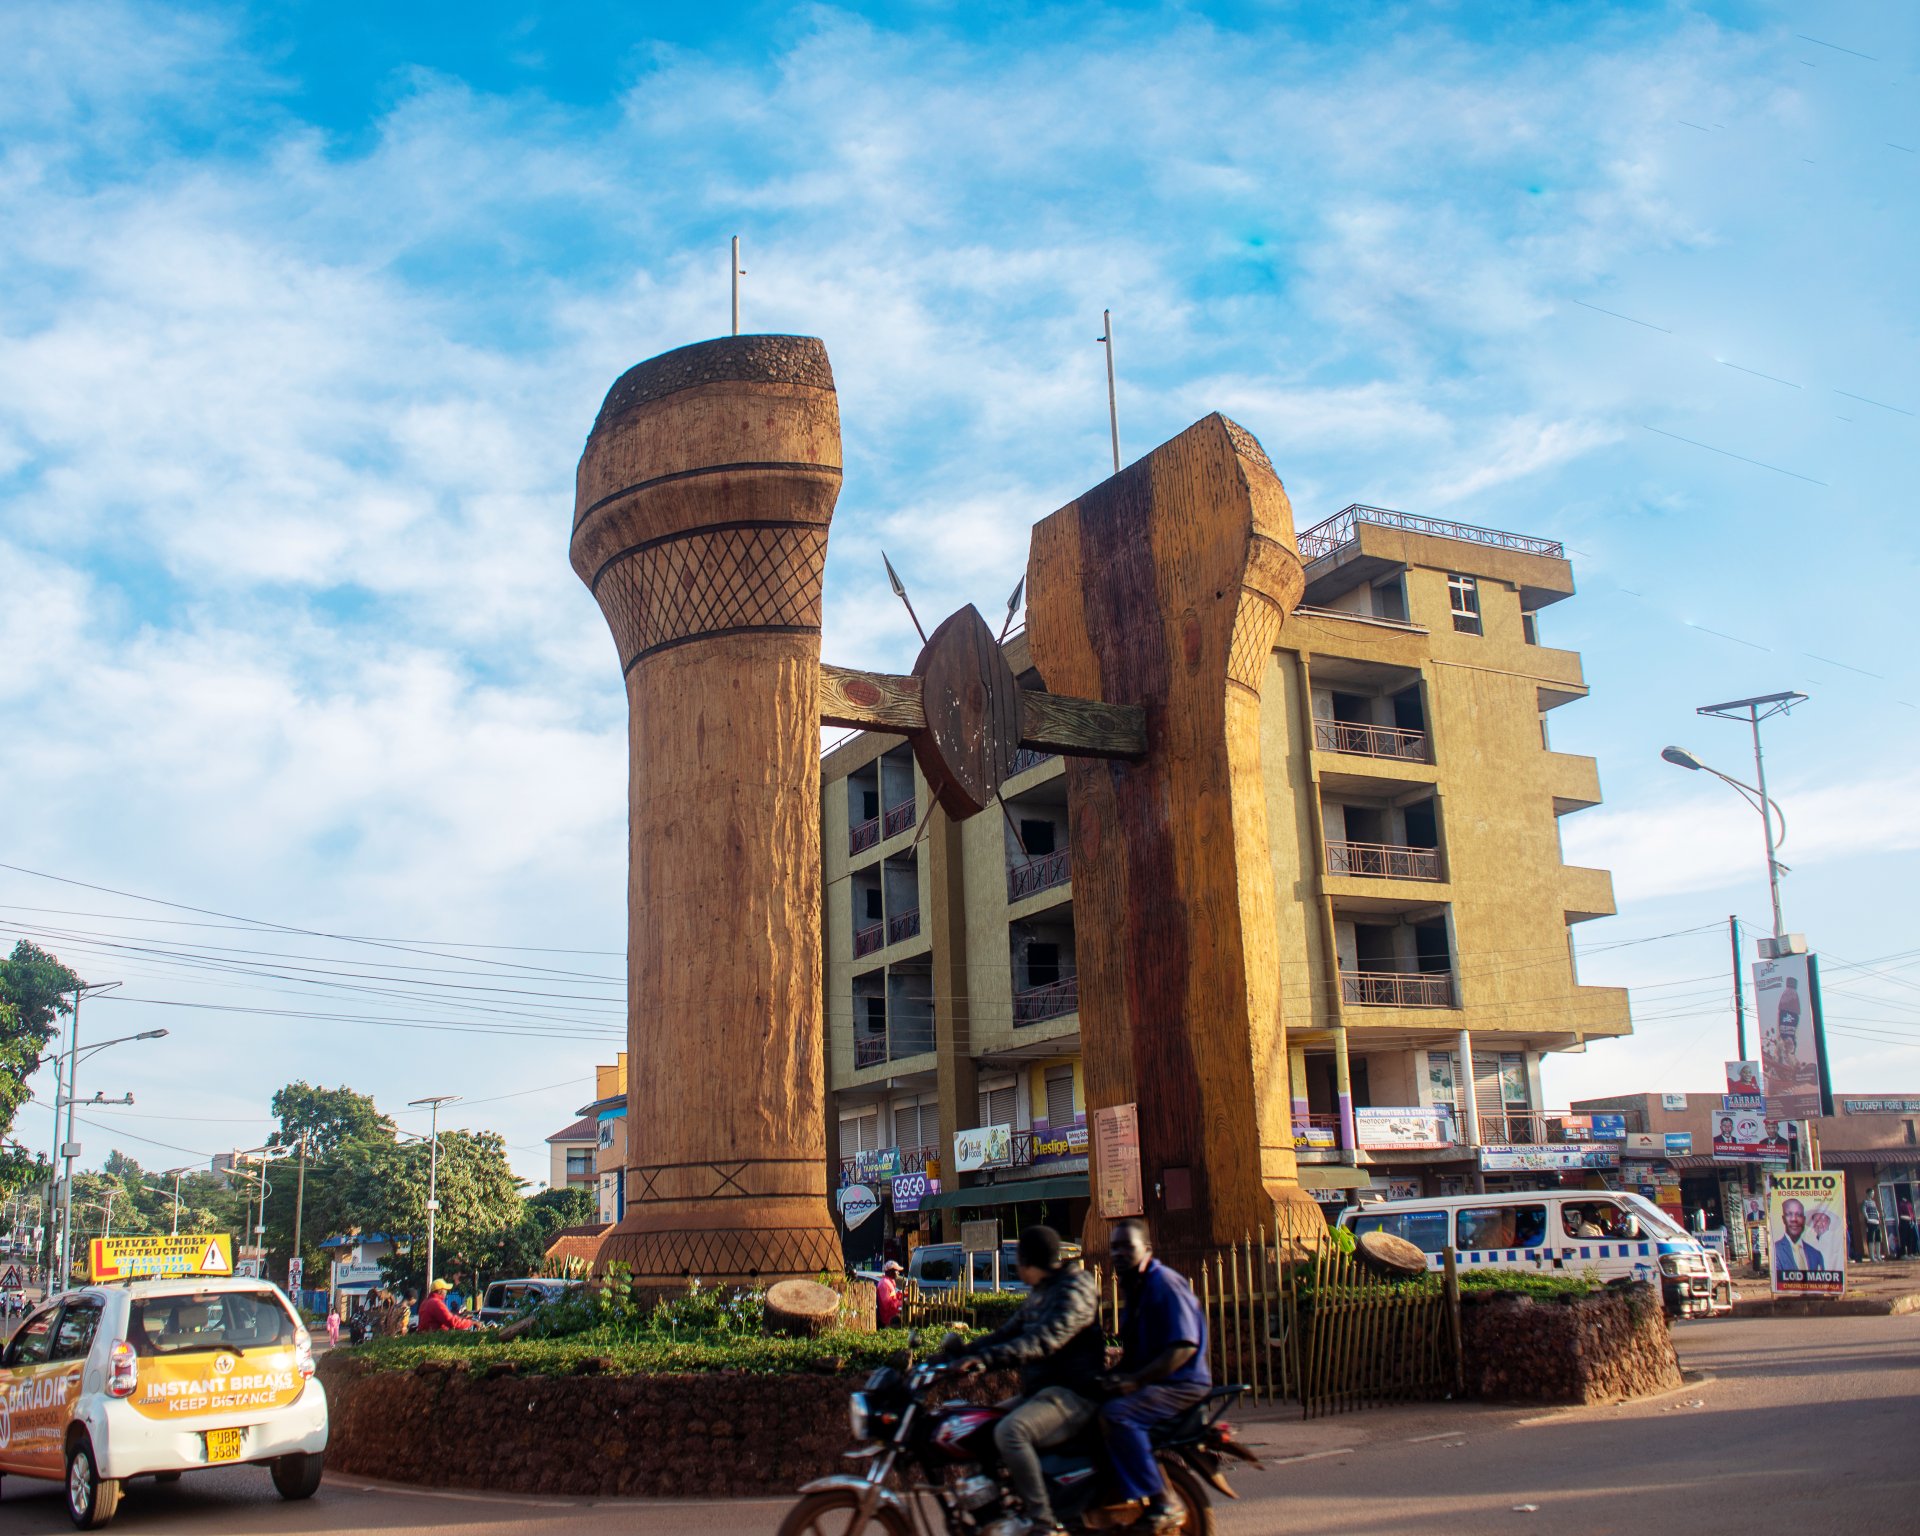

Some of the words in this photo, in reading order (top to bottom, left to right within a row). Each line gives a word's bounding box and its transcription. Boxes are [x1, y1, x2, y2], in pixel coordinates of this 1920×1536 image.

[1294, 1136, 1307, 1147] ge
[968, 1150, 982, 1158] FOODS
[894, 1175, 925, 1197] GOGO
[1772, 1175, 1836, 1190] KIZITO
[845, 1198, 873, 1211] GOGO
[106, 1238, 159, 1249] DRIVER
[165, 1237, 208, 1246] UNDER
[95, 1240, 119, 1277] L
[113, 1246, 200, 1257] INSTRUCTION
[1806, 1271, 1840, 1282] MAYOR
[147, 1377, 226, 1398] INSTANT
[230, 1372, 293, 1392] BREAKS
[9, 1375, 67, 1413] BANADIR
[169, 1397, 208, 1412] KEEP
[211, 1391, 277, 1409] DISTANCE
[36, 1411, 59, 1426] SCHOOL
[217, 1431, 238, 1445] UBP
